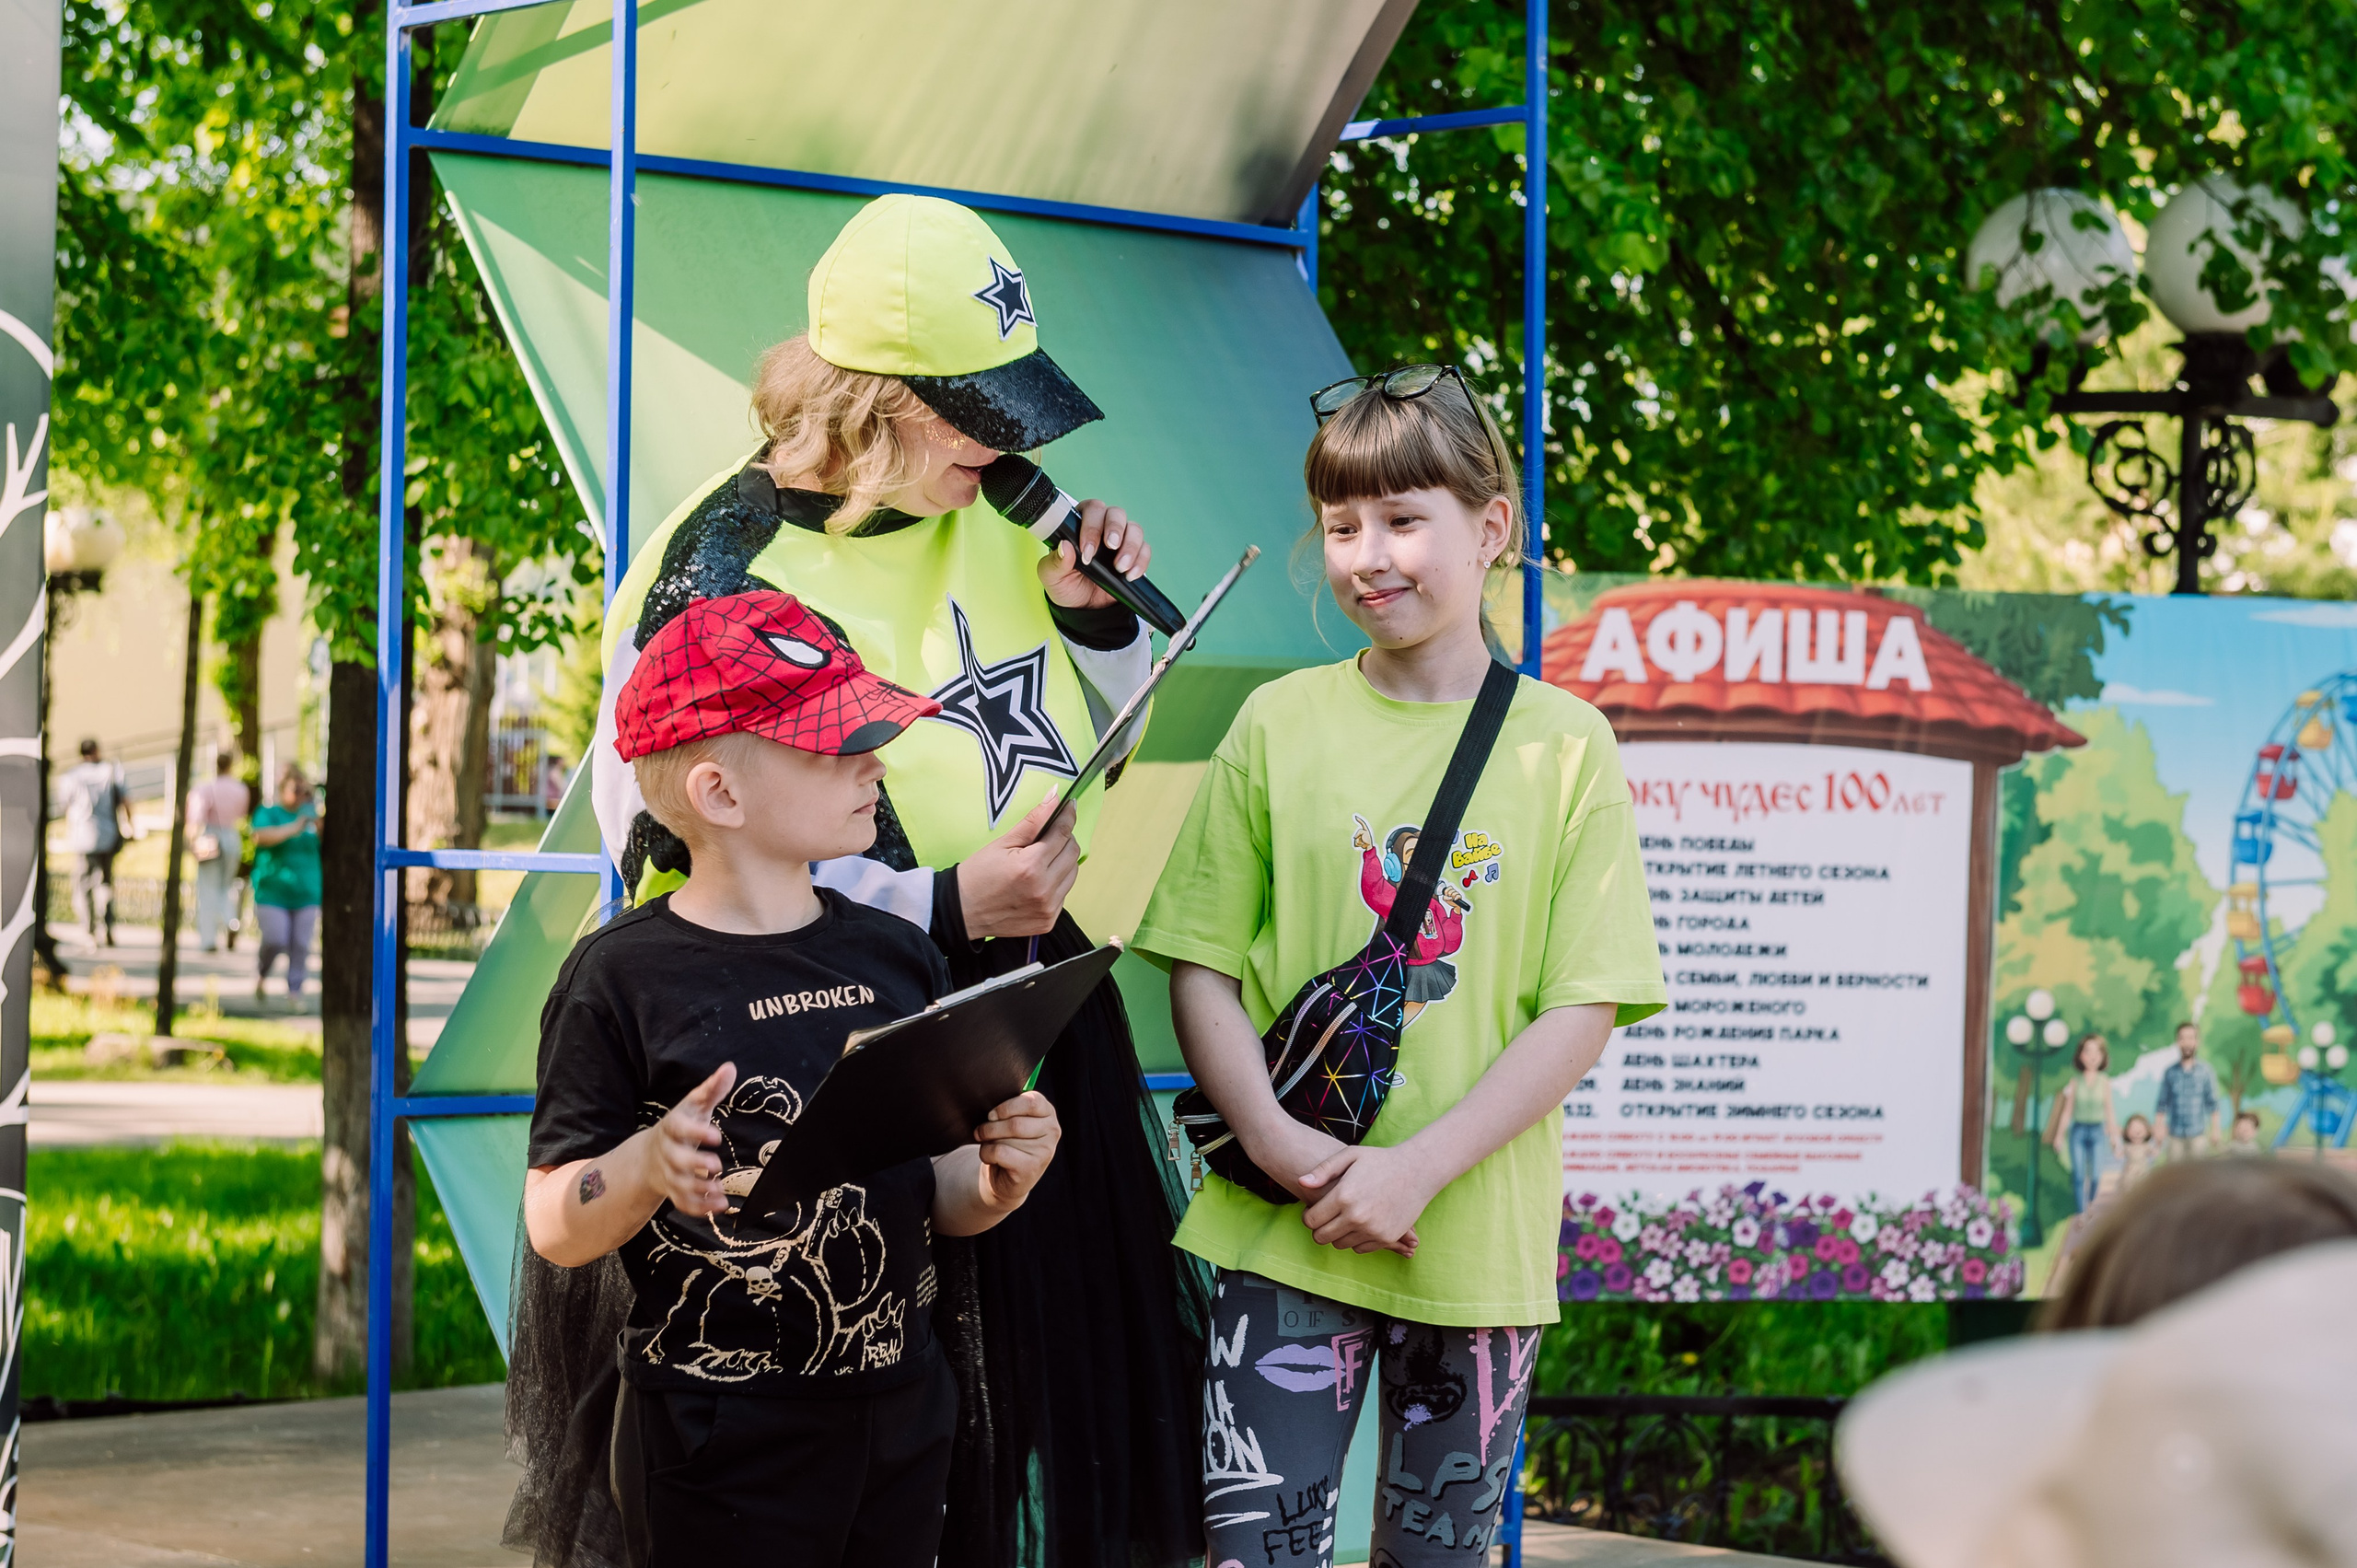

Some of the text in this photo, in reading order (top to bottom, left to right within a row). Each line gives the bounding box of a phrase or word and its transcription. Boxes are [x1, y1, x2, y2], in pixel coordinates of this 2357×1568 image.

[1579, 600, 1932, 691] АФИША
[1822, 771, 1890, 812] 100
[1680, 835, 1754, 852] ПОБЕДЫ
[1644, 860, 1889, 880] ТКРЫТИЕ ЛЕТНЕГО СЕЗОНА
[1681, 888, 1762, 903] ЗАЩИТЫ
[1769, 886, 1824, 903] ДЕТЕЙ
[1678, 914, 1749, 931] ГОРОДА
[1678, 942, 1787, 958] МОЛОДЕЖИ
[1750, 971, 1812, 987] ЛЮБВИ
[1818, 973, 1830, 987] И
[1837, 972, 1928, 990] ВЕРНОСТИ
[749, 984, 875, 1021] UNBROKEN
[1676, 999, 1805, 1016] МОРОЖЕНОГО
[1624, 1025, 1840, 1042] ДЕНЬ РОЖДЕНИЯ ПАРКА
[1623, 1053, 1759, 1069] ДЕНЬ ШАХТЕРА
[1622, 1077, 1664, 1093] ДЕНЬ
[1674, 1074, 1746, 1093] ЗНАНИЙ
[1620, 1103, 1717, 1119] ОТКРЫТИЕ
[1727, 1105, 1806, 1121] ЗИМНЕГО
[1813, 1106, 1884, 1121] СЕЗОНА
[1283, 1309, 1324, 1328] OF
[1387, 1432, 1512, 1513] LPS
[1382, 1487, 1491, 1556] TEAM
